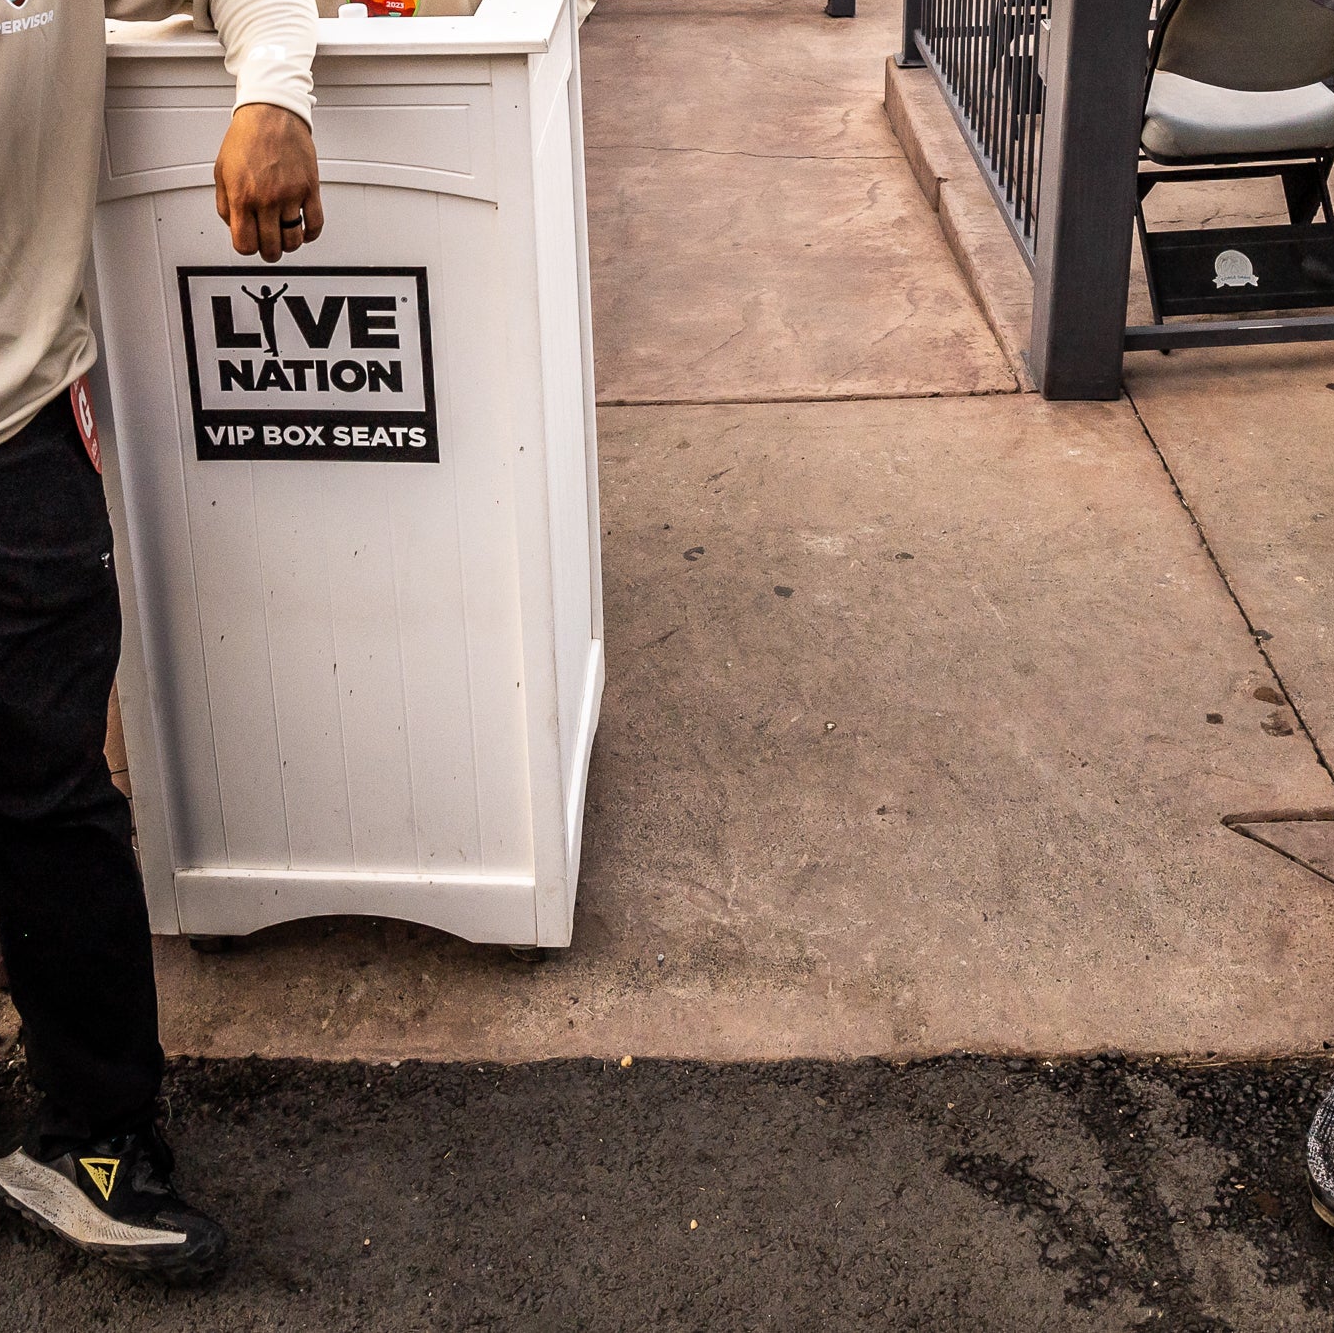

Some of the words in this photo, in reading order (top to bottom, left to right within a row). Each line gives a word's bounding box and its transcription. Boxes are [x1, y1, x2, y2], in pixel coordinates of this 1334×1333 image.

[210, 284, 401, 356] LIVE
[218, 359, 404, 393] NATION
[204, 425, 255, 447] VIP
[262, 425, 326, 446] BOX
[333, 426, 427, 448] SEATS
